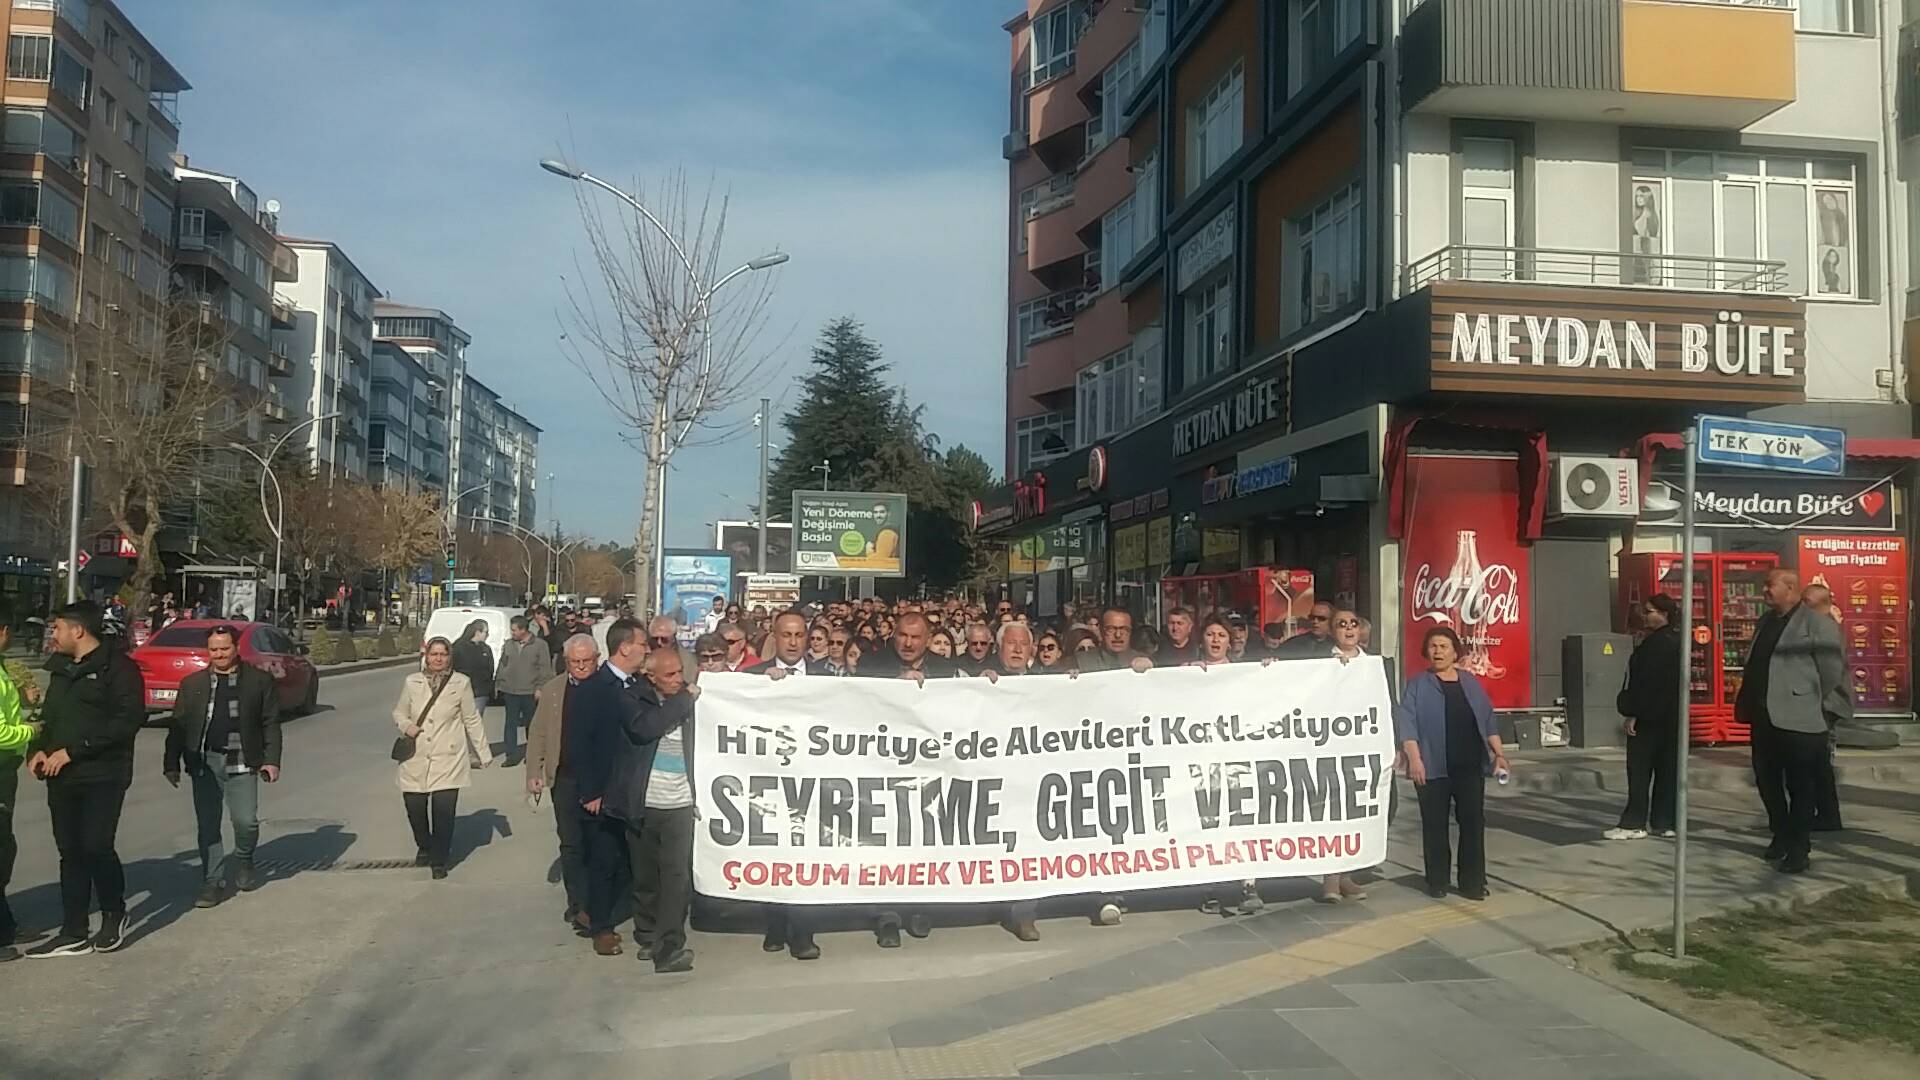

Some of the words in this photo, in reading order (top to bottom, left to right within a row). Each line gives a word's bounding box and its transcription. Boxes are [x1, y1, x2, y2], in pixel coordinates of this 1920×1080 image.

[1450, 312, 1656, 370] MEYDAN
[1681, 310, 1795, 376] BÜFE
[1173, 396, 1231, 458] MEYDAN
[1236, 377, 1279, 432] BÜFE
[1714, 434, 1749, 450] TEK
[1762, 437, 1801, 456] YÖN
[1618, 469, 1628, 506] VESTEL
[802, 507, 825, 517] Yeni
[829, 507, 873, 519] Döneme
[1693, 491, 1792, 518] Meydan
[1796, 493, 1853, 516] Büfe
[802, 519, 856, 531] Değişimle
[802, 532, 832, 544] Başla
[1804, 539, 1855, 551] Sevdiğiniz
[1856, 540, 1900, 551] Lezzetler
[1818, 554, 1848, 566] Uygun
[1850, 554, 1888, 567] Fiyatlar
[1411, 563, 1520, 625] Coca-Cola
[717, 725, 798, 767] HTŞ
[808, 724, 998, 765] Suriye'de
[1005, 716, 1154, 756] Alevileri
[1161, 707, 1378, 747] Katlediyor!
[709, 775, 1017, 852] SEYRETME,
[1037, 752, 1170, 845] GEÇİT
[1188, 753, 1381, 830] VERME!
[723, 860, 850, 890] ÇORUM
[858, 861, 951, 886] EMEK
[958, 860, 995, 885] VE
[1000, 838, 1180, 882] DEMOKRASİ
[1186, 833, 1361, 866] PLATFORMU
